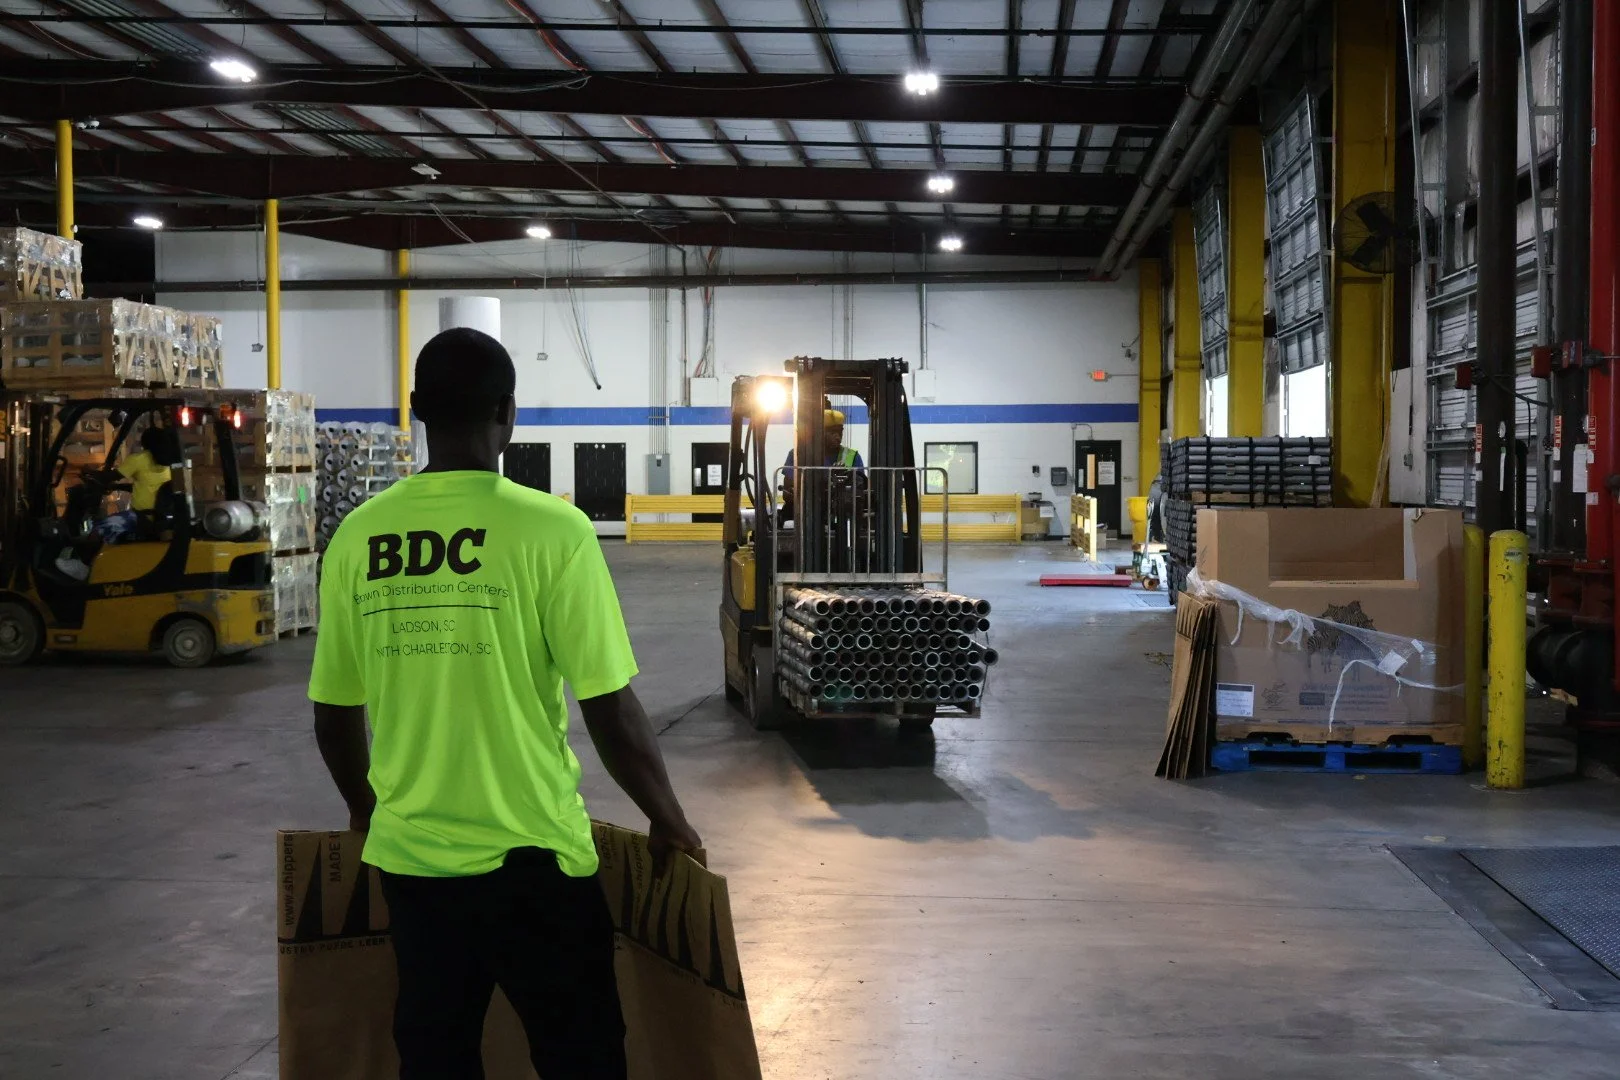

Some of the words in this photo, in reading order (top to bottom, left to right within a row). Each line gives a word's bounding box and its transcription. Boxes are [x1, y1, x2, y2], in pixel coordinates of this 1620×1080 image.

[366, 527, 487, 581] BDC
[103, 582, 134, 597] Yale
[382, 583, 454, 597] Distribution
[457, 581, 509, 598] Centers
[392, 620, 442, 634] LADSON,
[443, 620, 456, 632] SC
[402, 642, 473, 656] CHARLETON,
[476, 642, 492, 655] SC
[328, 842, 342, 882] MADE
